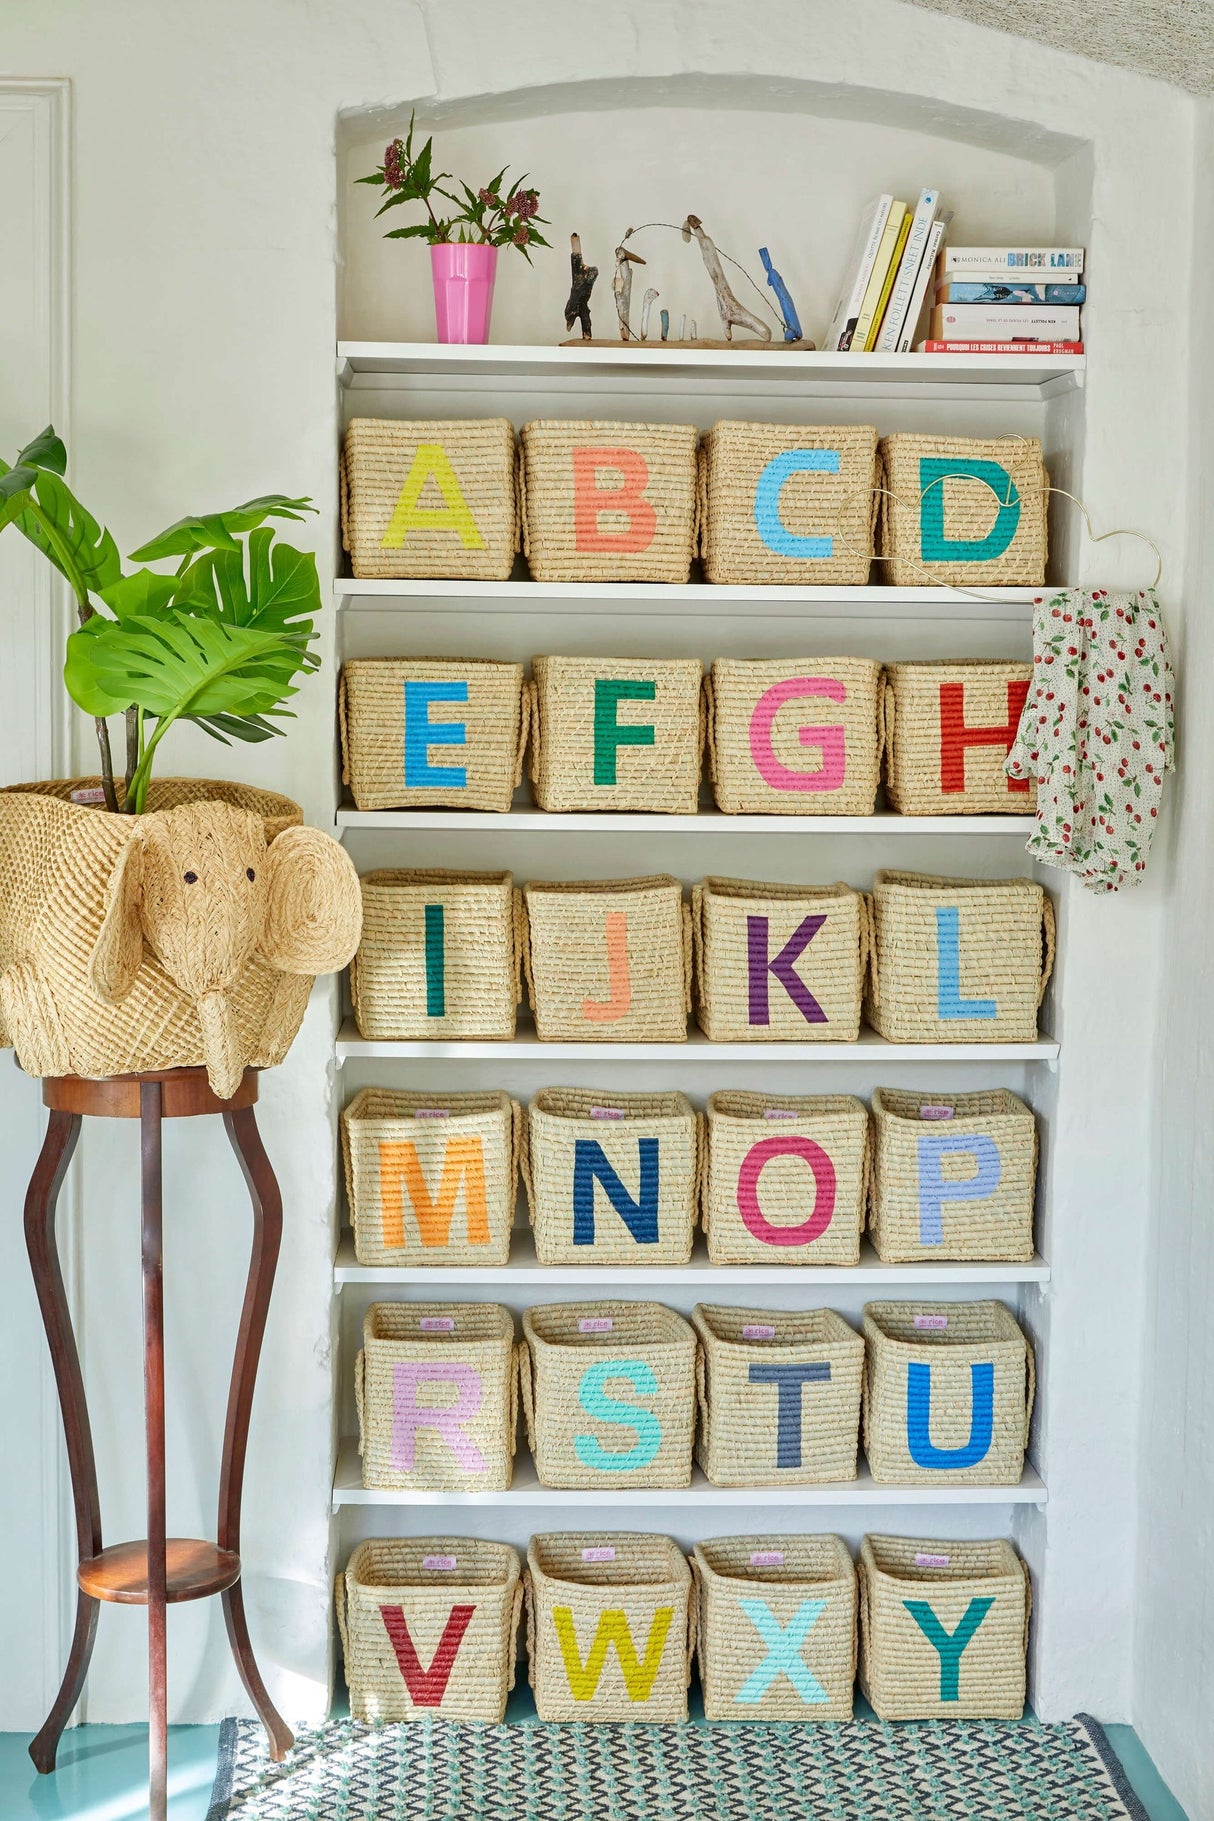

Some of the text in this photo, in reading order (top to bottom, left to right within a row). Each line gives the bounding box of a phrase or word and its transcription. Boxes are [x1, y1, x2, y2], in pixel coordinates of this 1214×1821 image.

[903, 245, 919, 277] SNEET
[912, 216, 928, 243] INDE
[1008, 253, 1082, 267] BRICK LANE
[882, 327, 896, 351] KEN
[889, 281, 909, 326] FOLLETT
[381, 443, 485, 550] A
[571, 447, 657, 554] B
[754, 448, 841, 558] C
[919, 457, 1021, 562] D
[403, 682, 469, 788] E
[592, 679, 656, 786] F
[749, 675, 846, 792] G
[939, 679, 1033, 793] H
[425, 904, 444, 1017] I
[583, 912, 631, 1022] J
[747, 914, 829, 1025] K
[936, 906, 997, 1020] L
[379, 1136, 490, 1248] M
[572, 1137, 660, 1245] N
[736, 1135, 836, 1247] O
[917, 1134, 1002, 1246] P
[391, 1361, 488, 1473] R
[574, 1360, 662, 1471] S
[748, 1361, 831, 1468] T
[908, 1363, 994, 1469] U
[379, 1605, 477, 1707] V
[553, 1606, 674, 1702] W
[734, 1599, 830, 1704] X
[902, 1597, 996, 1702] Y
